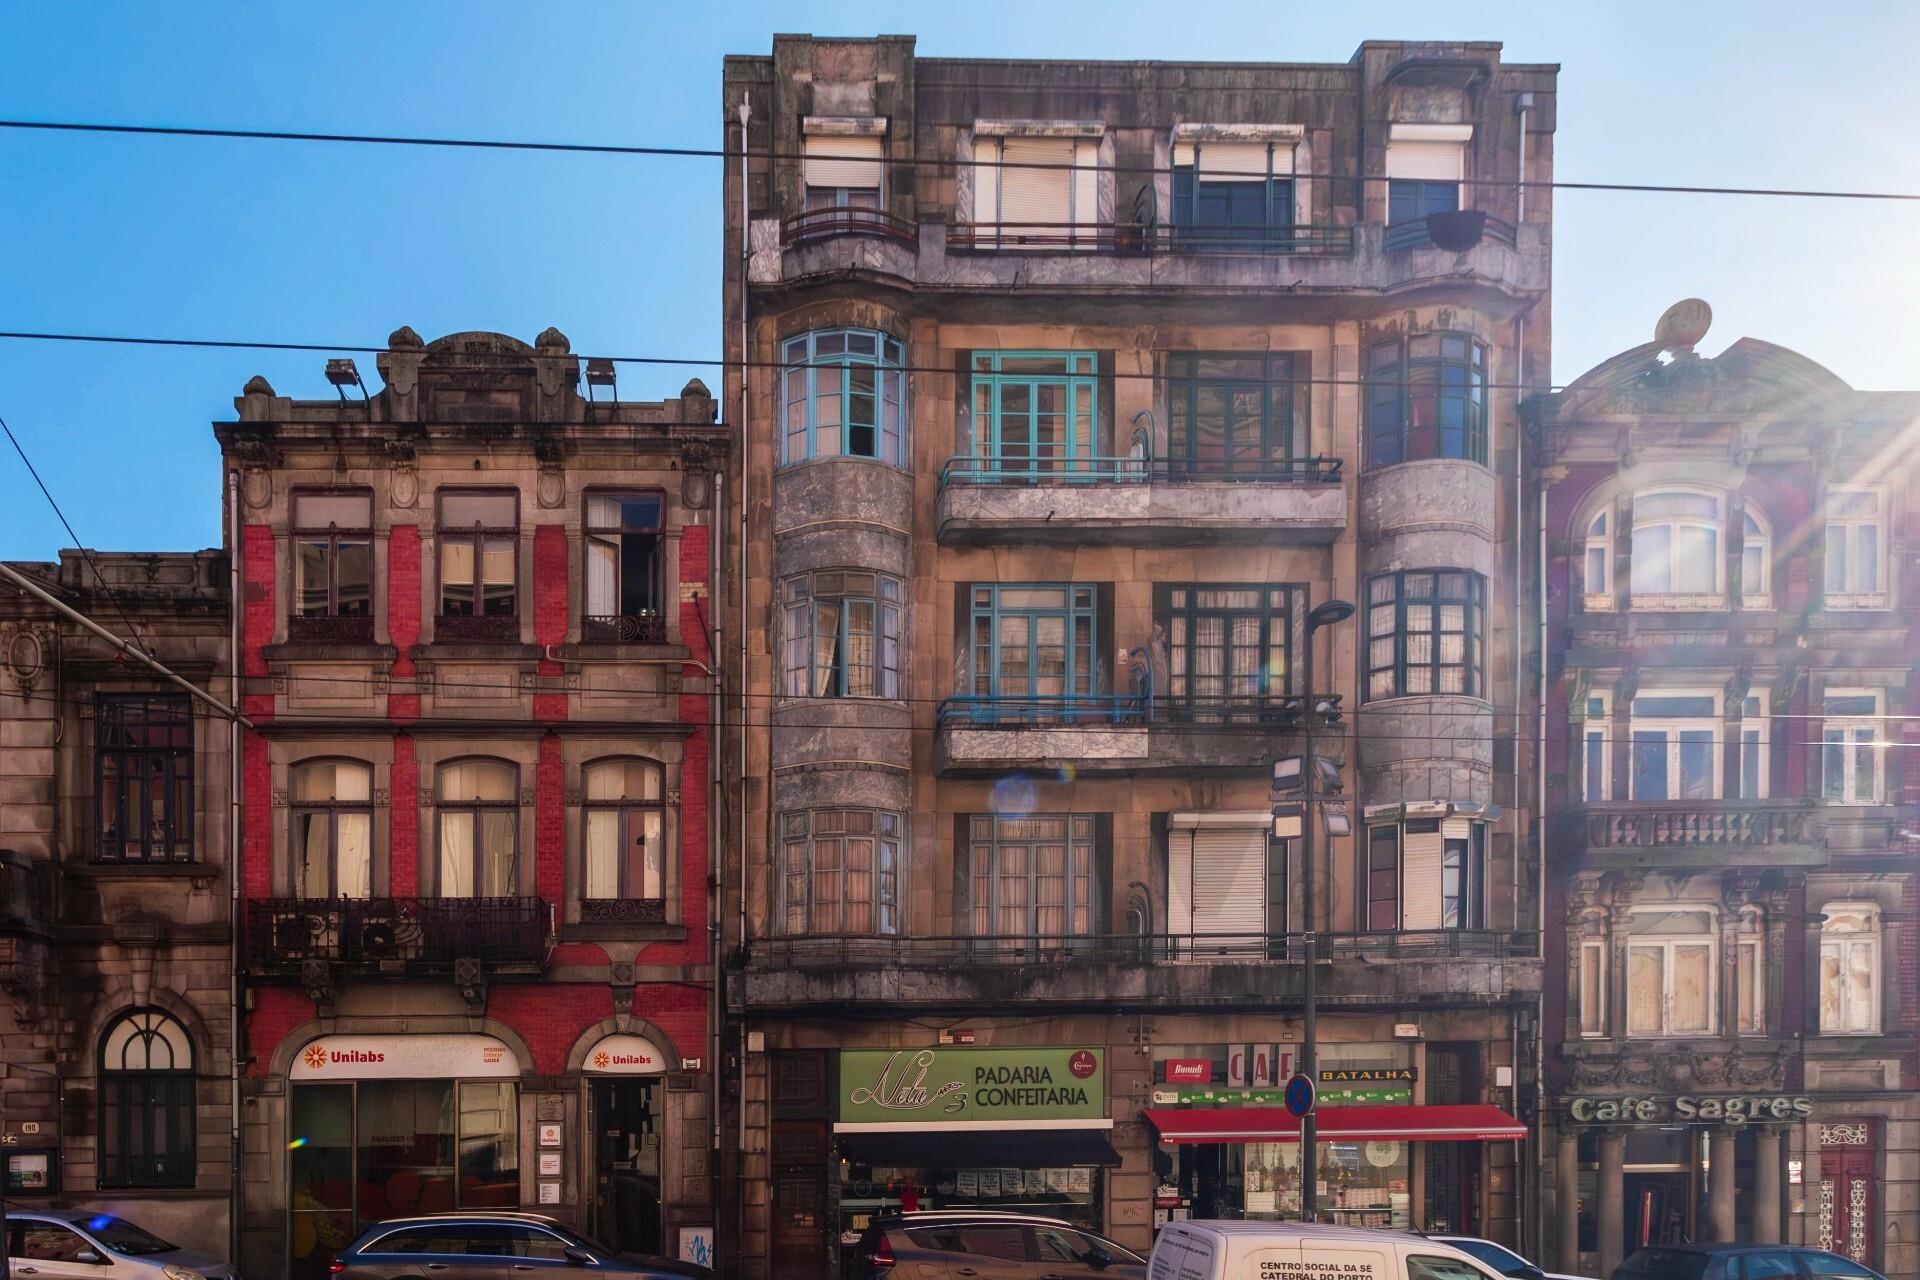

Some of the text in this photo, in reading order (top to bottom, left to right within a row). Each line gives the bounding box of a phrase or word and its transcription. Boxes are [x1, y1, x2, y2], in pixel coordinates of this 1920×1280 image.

[331, 1050, 384, 1063] Unilabs
[612, 1055, 651, 1065] Unilabs
[1230, 1052, 1293, 1081] CAF
[975, 1066, 1053, 1085] PADARIA
[1322, 1070, 1412, 1080] BATALHA
[944, 1092, 969, 1113] 3
[975, 1087, 1089, 1106] CONFEITARIA
[1571, 1096, 1814, 1126] Café Sagres
[1260, 1262, 1302, 1271] CENTRO
[1304, 1263, 1342, 1271] SOCIAL
[1344, 1263, 1357, 1272] DA
[1260, 1271, 1317, 1280] CATEDRAL
